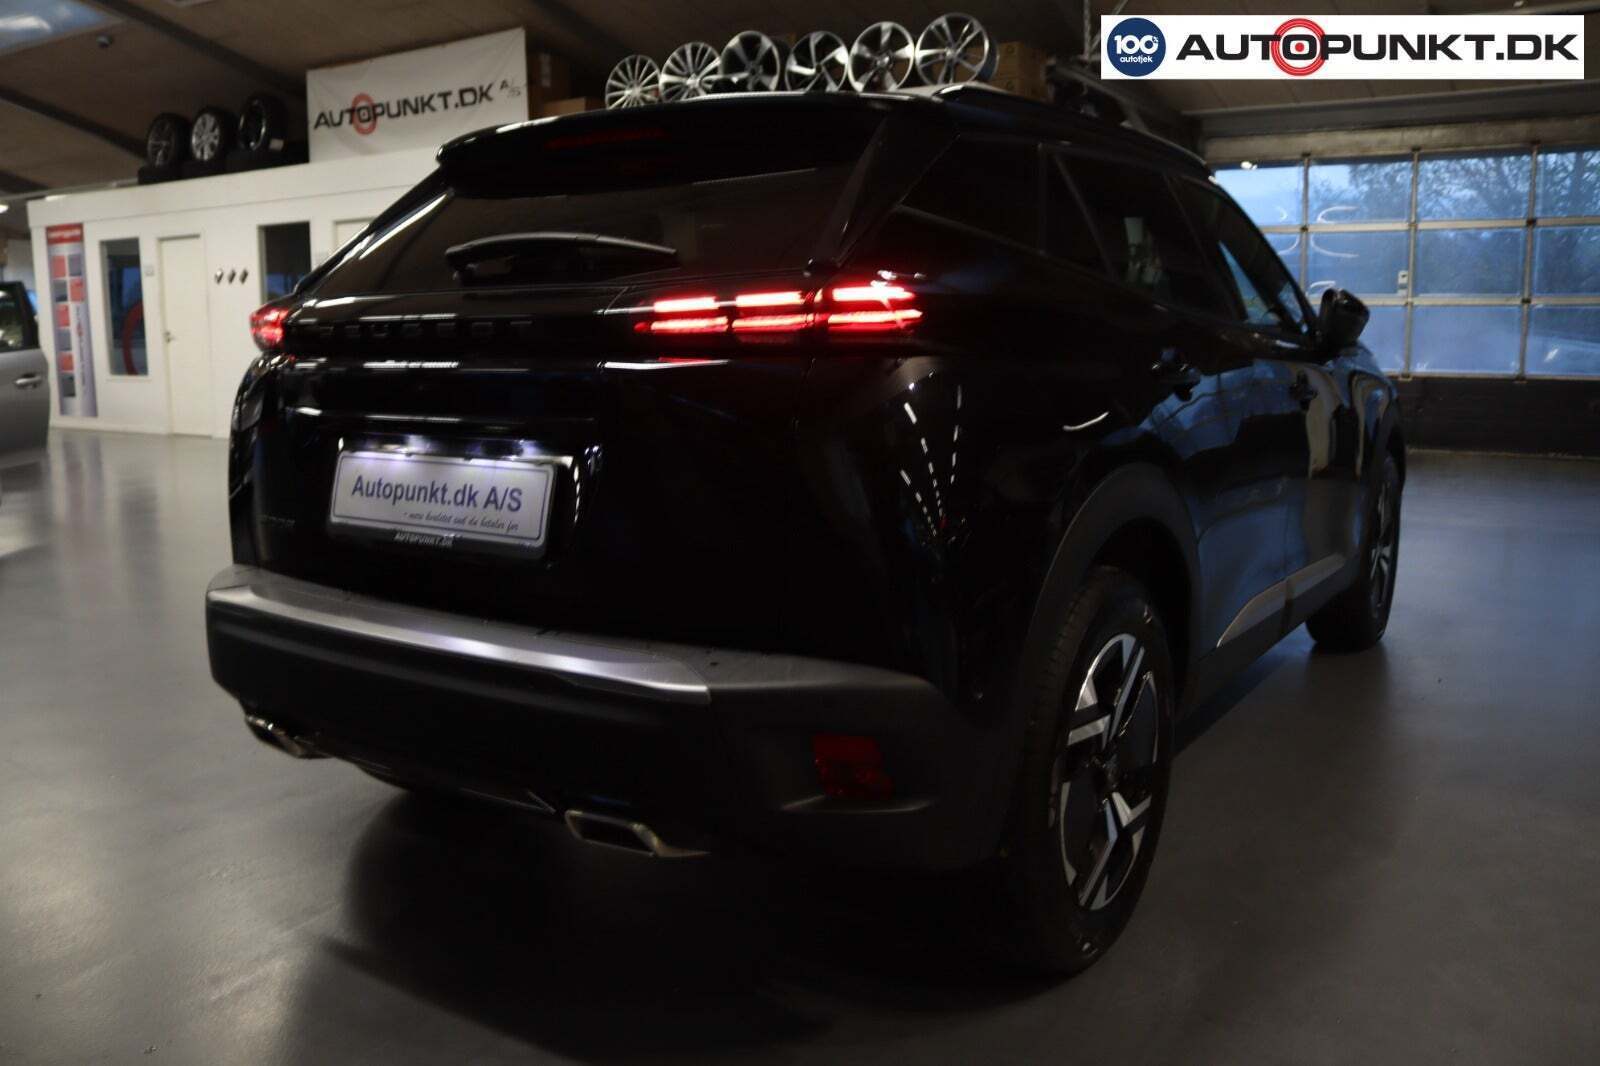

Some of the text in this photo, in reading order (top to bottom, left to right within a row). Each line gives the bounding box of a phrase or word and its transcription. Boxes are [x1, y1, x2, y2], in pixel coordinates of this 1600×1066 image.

[313, 82, 495, 130] AUTOPUNKT.DK
[351, 474, 523, 513] Autopunkt.dk A/S
